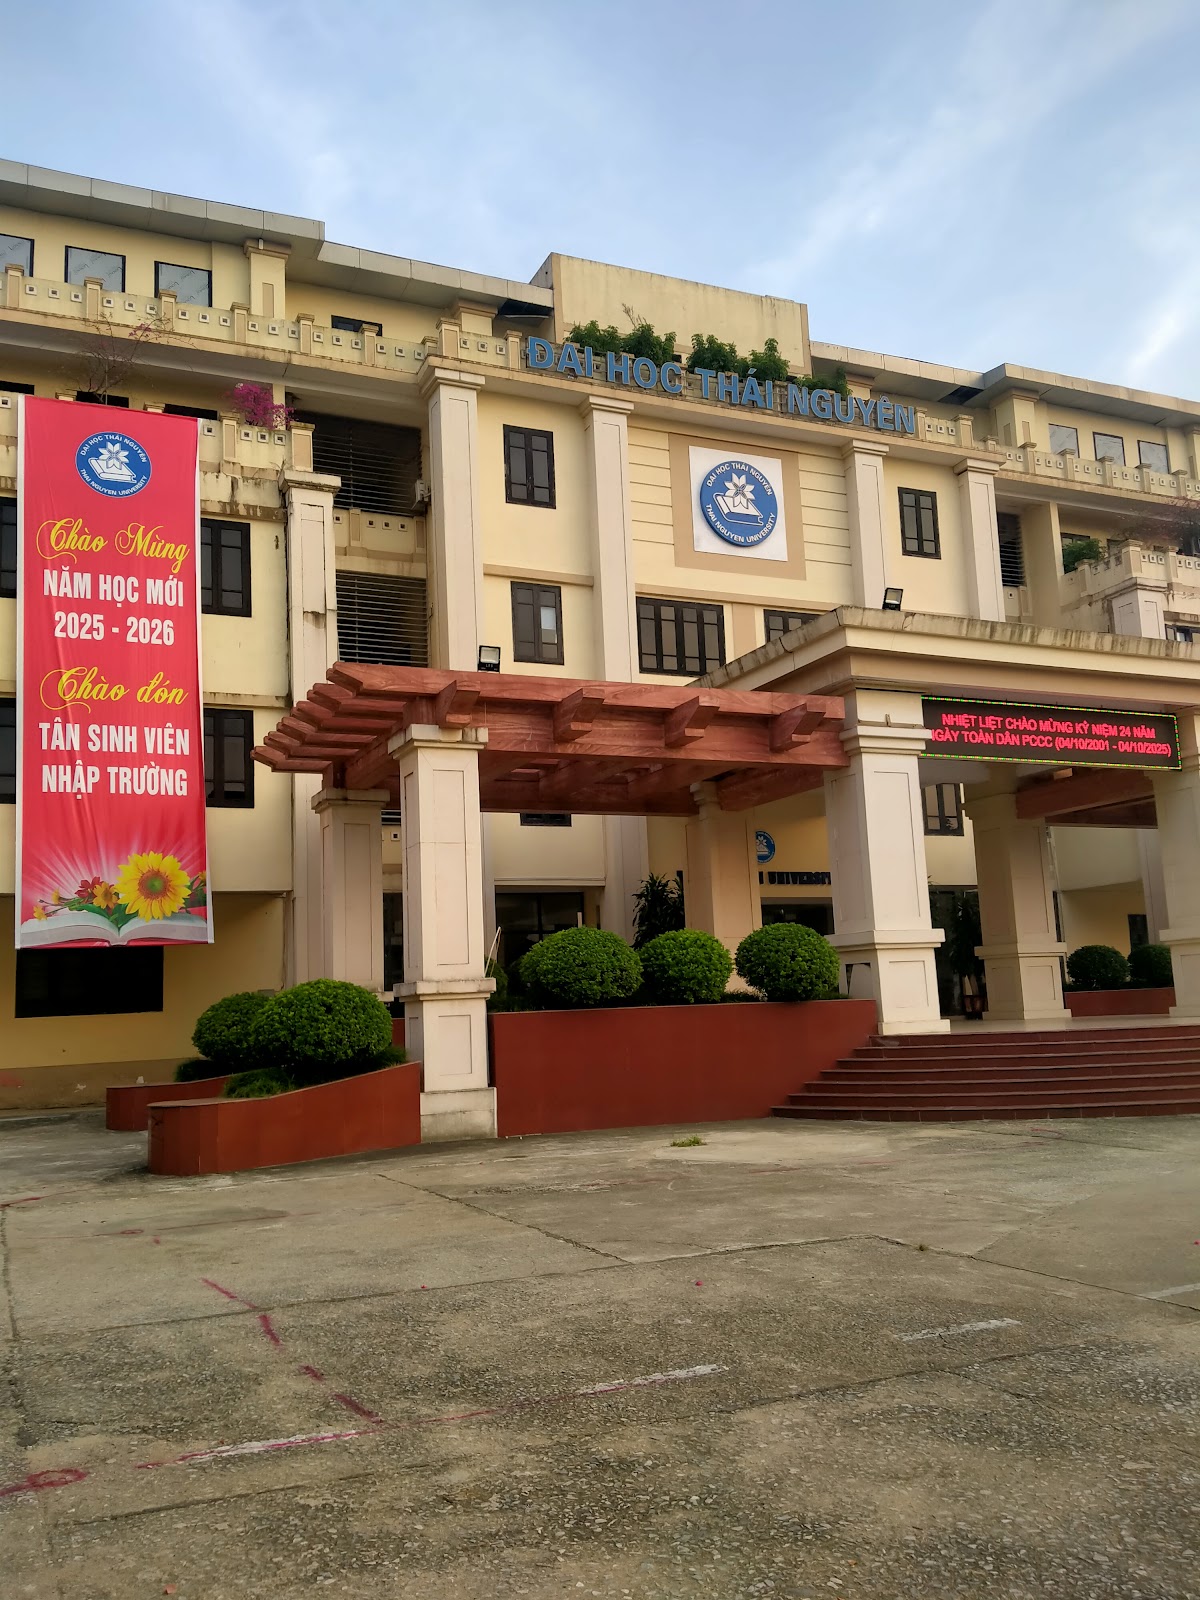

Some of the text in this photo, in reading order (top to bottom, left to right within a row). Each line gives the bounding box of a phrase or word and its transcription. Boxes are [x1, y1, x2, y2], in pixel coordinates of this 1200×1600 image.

[695, 367, 774, 410] THÁI
[787, 384, 916, 434] NGUYÊN
[104, 434, 122, 442] THÁI
[80, 468, 147, 496] THAI NGUYEN UNIVERSITY
[731, 462, 749, 472] THÁI
[706, 504, 775, 543] THAI NGUYEN UNIVERSITY
[36, 517, 190, 574] Chào Mừng
[43, 565, 184, 608] NĂM HỌC MỚI
[54, 611, 104, 641] 2025
[126, 616, 175, 646] 2026
[39, 666, 189, 714] Chào đón
[38, 716, 190, 755] TÂN SINH VIÊN
[941, 713, 977, 729] NHIỆT
[978, 715, 1003, 730] LIỆT
[1005, 716, 1037, 731] CHÀO
[1039, 718, 1074, 733] MỪNG
[1091, 723, 1118, 738] NIỆM
[1119, 725, 1132, 738] 24
[1133, 724, 1156, 739] NĂM
[961, 729, 994, 745] TOÀN
[995, 730, 1020, 746] DÂN
[1022, 734, 1053, 748] PCCC
[1054, 736, 1110, 751] (04/10/2001
[1118, 741, 1172, 758] 04/10/2025)
[42, 759, 188, 800] NHẬP TRƯỜNG
